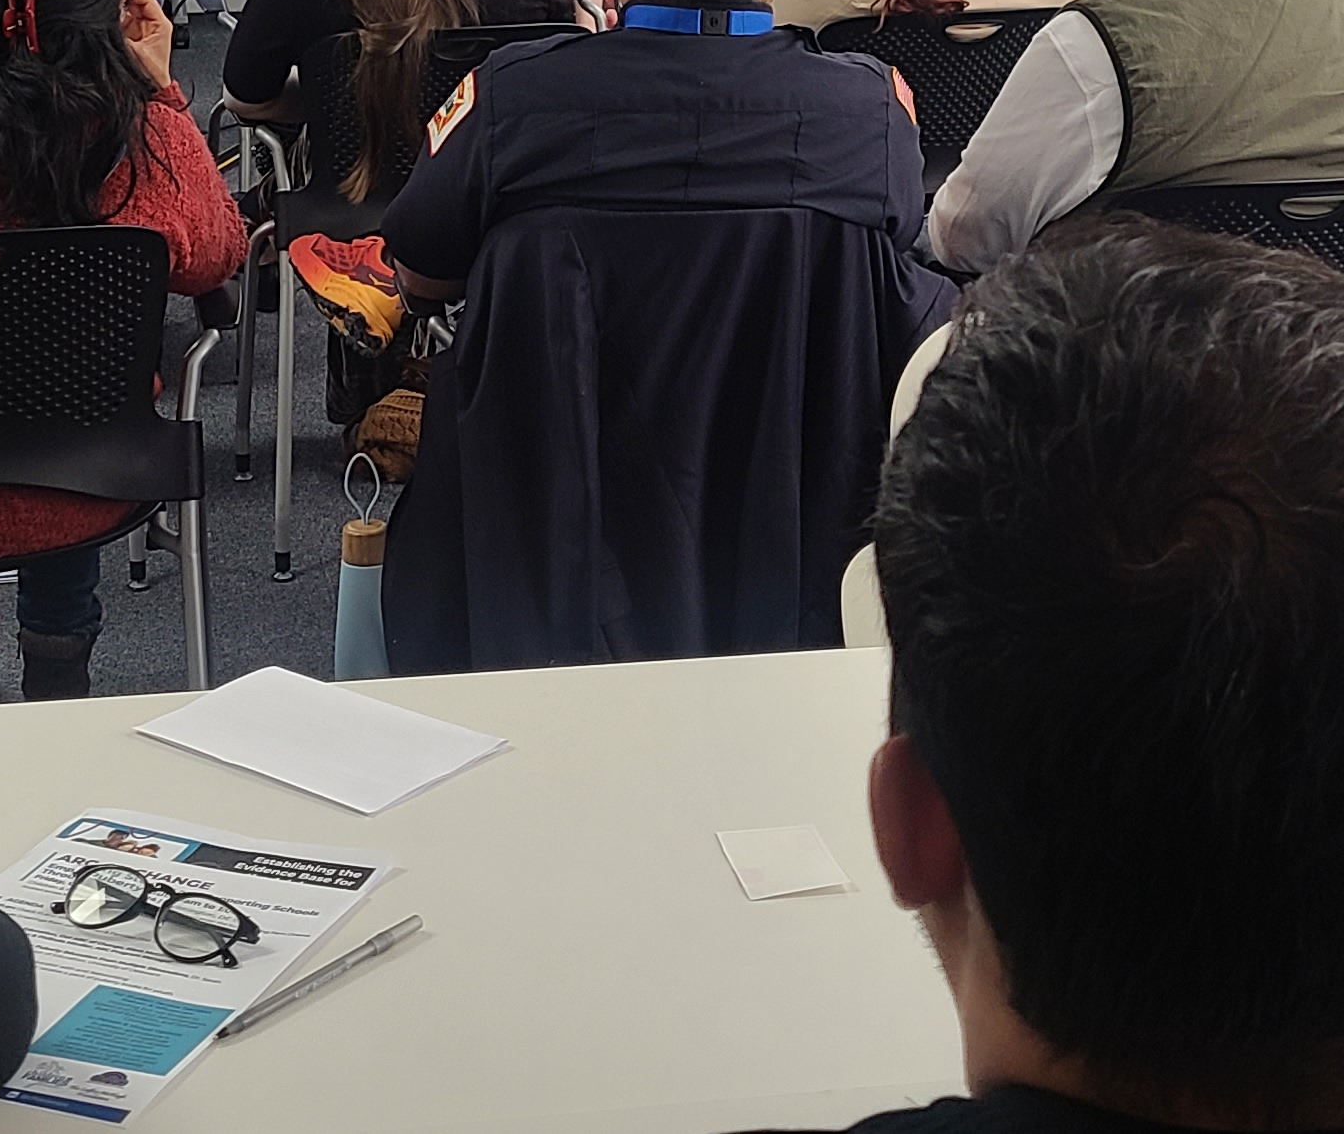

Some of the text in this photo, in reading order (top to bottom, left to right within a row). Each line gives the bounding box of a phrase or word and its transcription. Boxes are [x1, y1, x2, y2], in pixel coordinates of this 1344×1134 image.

[234, 862, 356, 887] Evidence Base for
[253, 856, 364, 879] Establishing the
[220, 897, 320, 916] porting Schools
